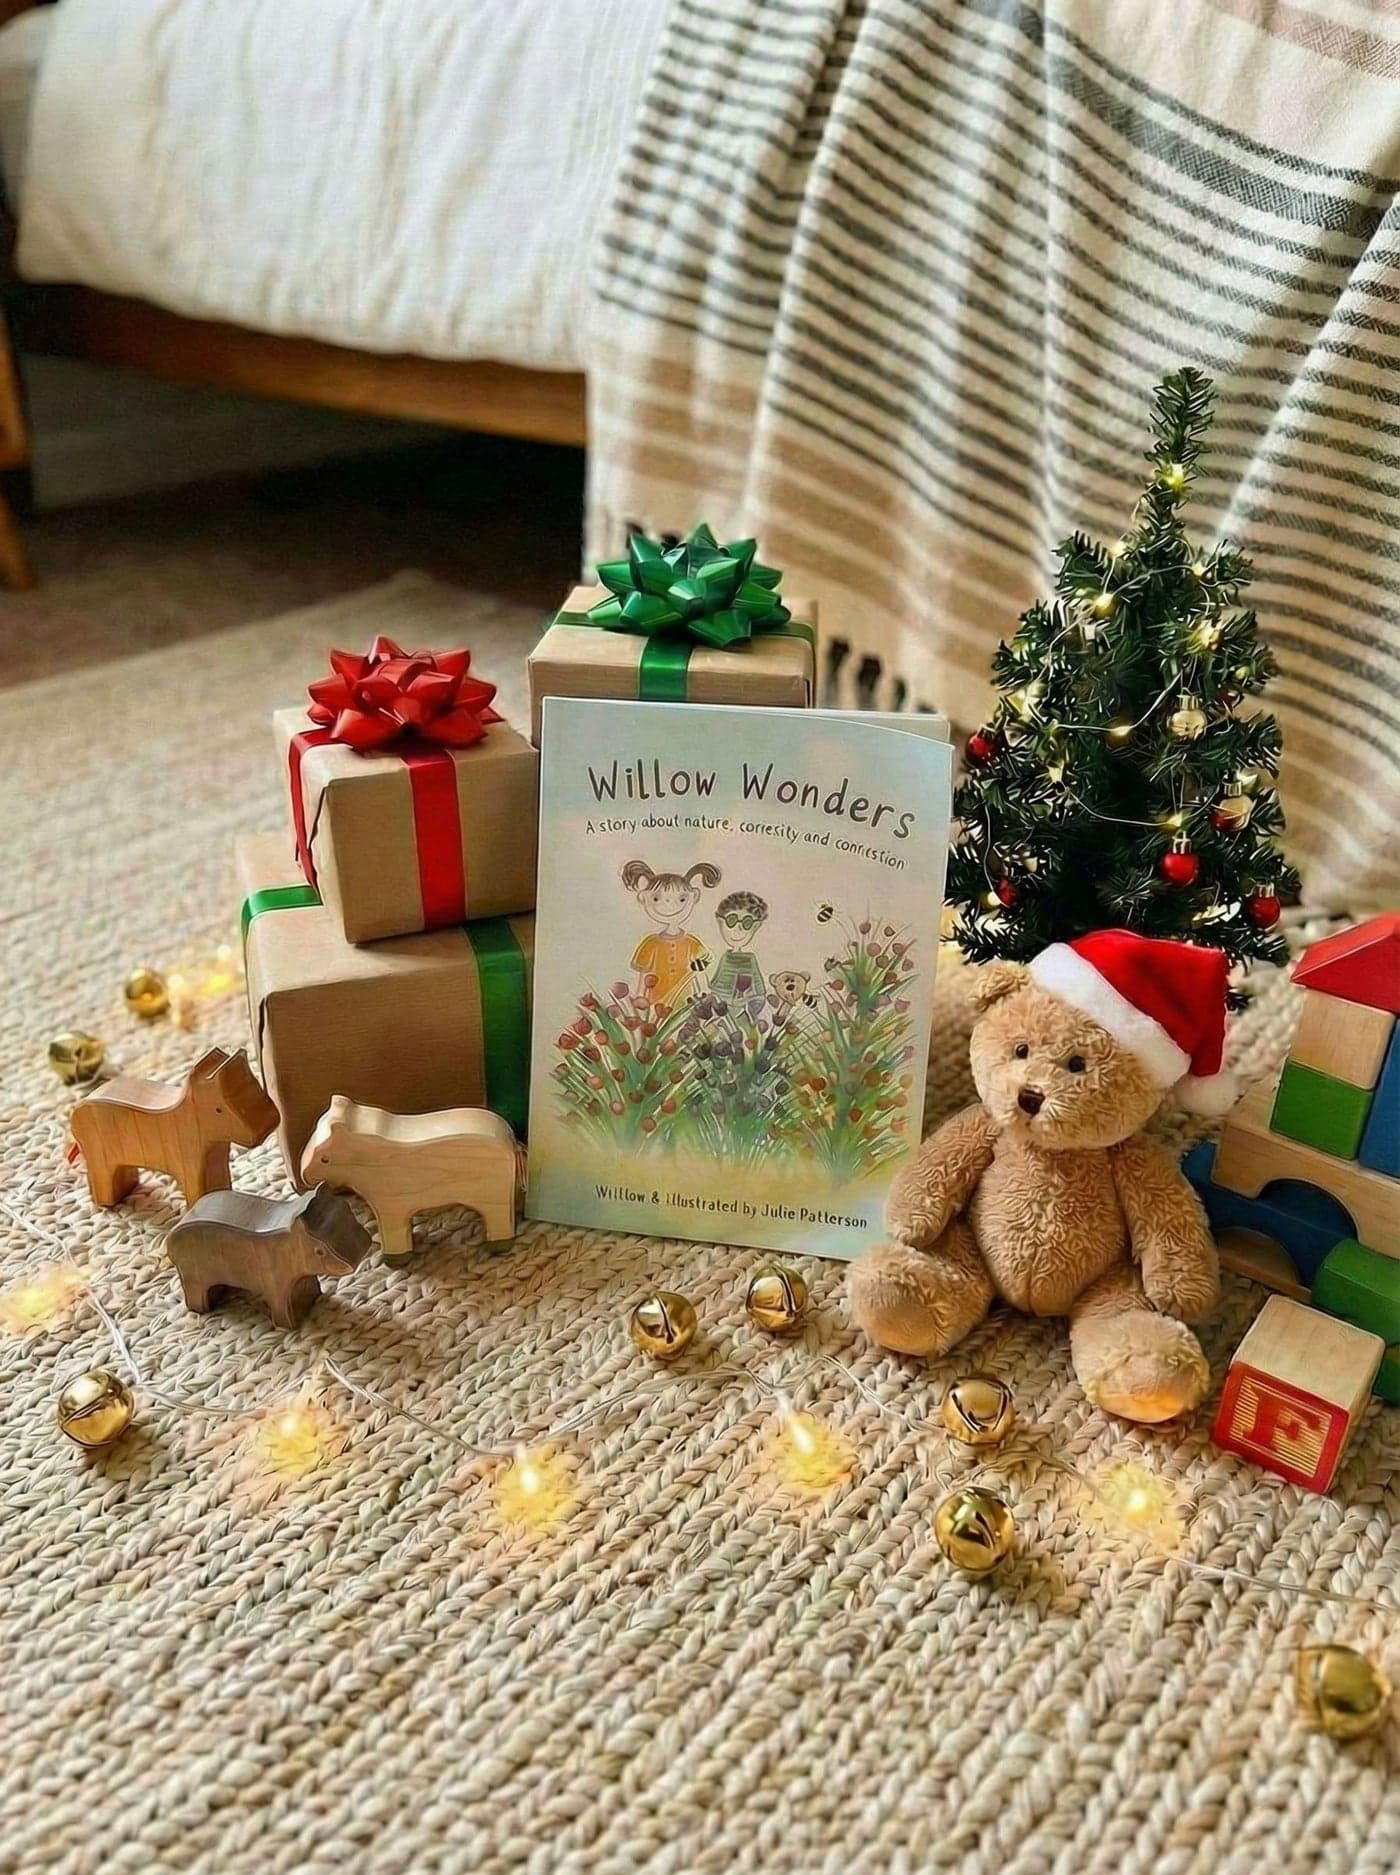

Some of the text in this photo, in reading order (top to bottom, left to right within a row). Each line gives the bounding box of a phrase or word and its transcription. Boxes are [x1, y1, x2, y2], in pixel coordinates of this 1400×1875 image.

[588, 758, 915, 839] Willow Wonders
[586, 820, 595, 835] A
[600, 818, 637, 833] story
[641, 812, 679, 828] about
[804, 832, 831, 846] and
[651, 1190, 660, 1205] &
[743, 1201, 757, 1219] by
[761, 1203, 796, 1220] Julie
[800, 1207, 867, 1229] Patterson
[1242, 1384, 1321, 1451] F
